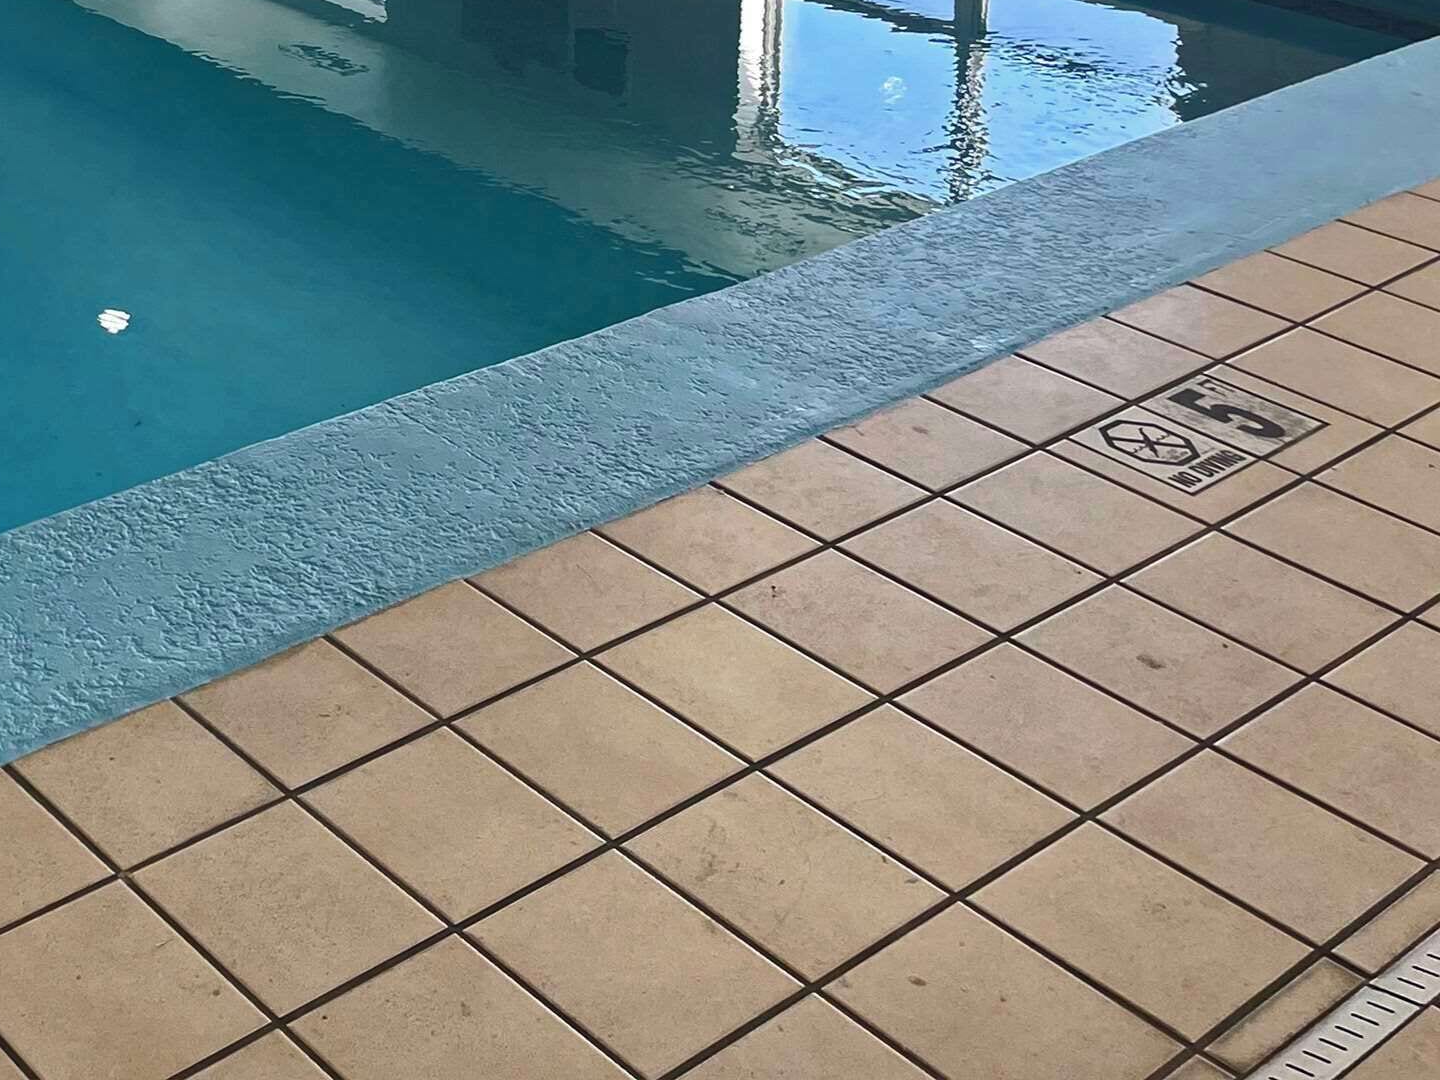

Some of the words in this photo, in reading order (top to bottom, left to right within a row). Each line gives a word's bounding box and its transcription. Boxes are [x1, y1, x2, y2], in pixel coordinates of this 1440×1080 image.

[1166, 388, 1286, 438] 5
[1167, 472, 1203, 489] NO
[1188, 449, 1248, 479] DIVING
